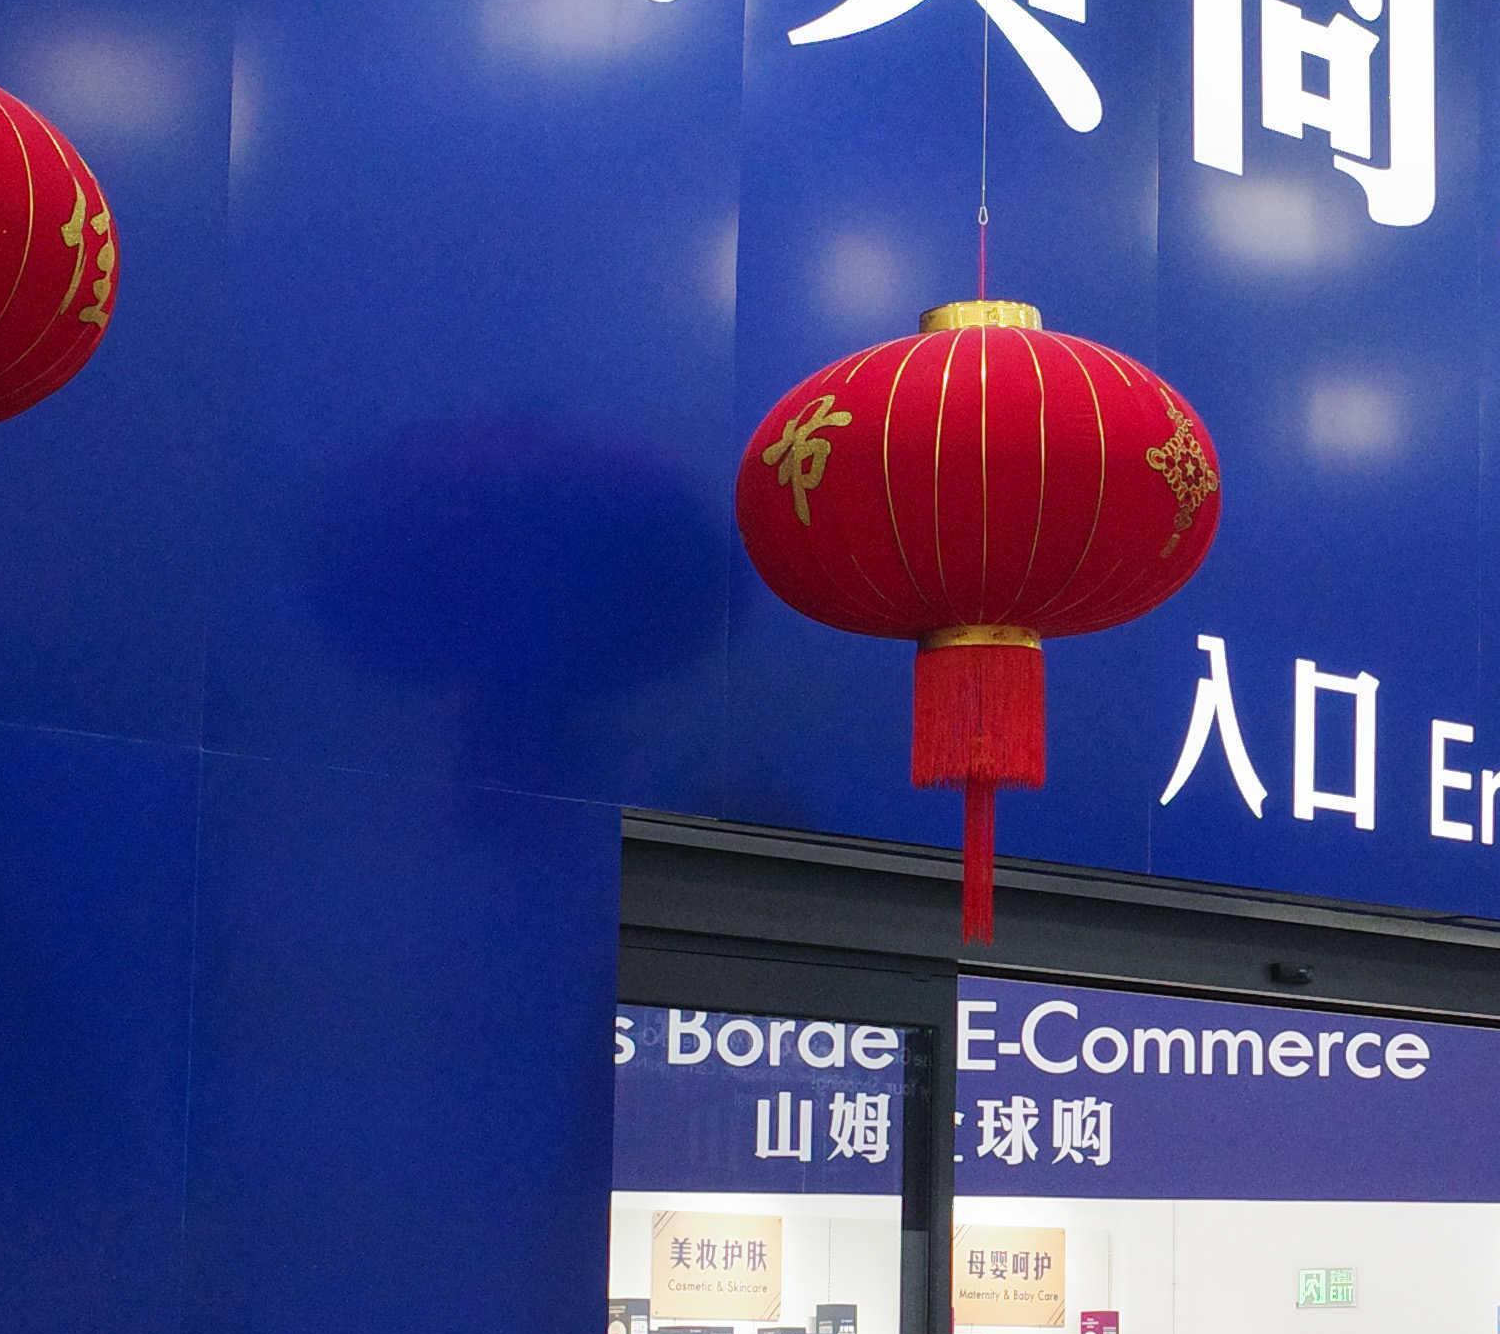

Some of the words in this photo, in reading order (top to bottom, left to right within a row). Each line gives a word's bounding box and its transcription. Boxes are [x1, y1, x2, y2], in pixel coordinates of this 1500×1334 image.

[1159, 634, 1380, 830] 入口
[668, 1008, 899, 1070] Borde
[957, 1000, 1431, 1080] E-Commerce
[754, 1090, 1114, 1166] 山姆球购
[669, 1236, 768, 1272] 美妆护肤
[967, 1249, 1053, 1281] 母婴呵护
[667, 1278, 713, 1293] Cosmetic
[716, 1279, 724, 1293] &
[727, 1280, 768, 1294] Skincare
[959, 1289, 1001, 1303] Maternity
[1003, 1289, 1010, 1300] &
[1013, 1290, 1035, 1303] Baby
[1037, 1290, 1059, 1302] Care
